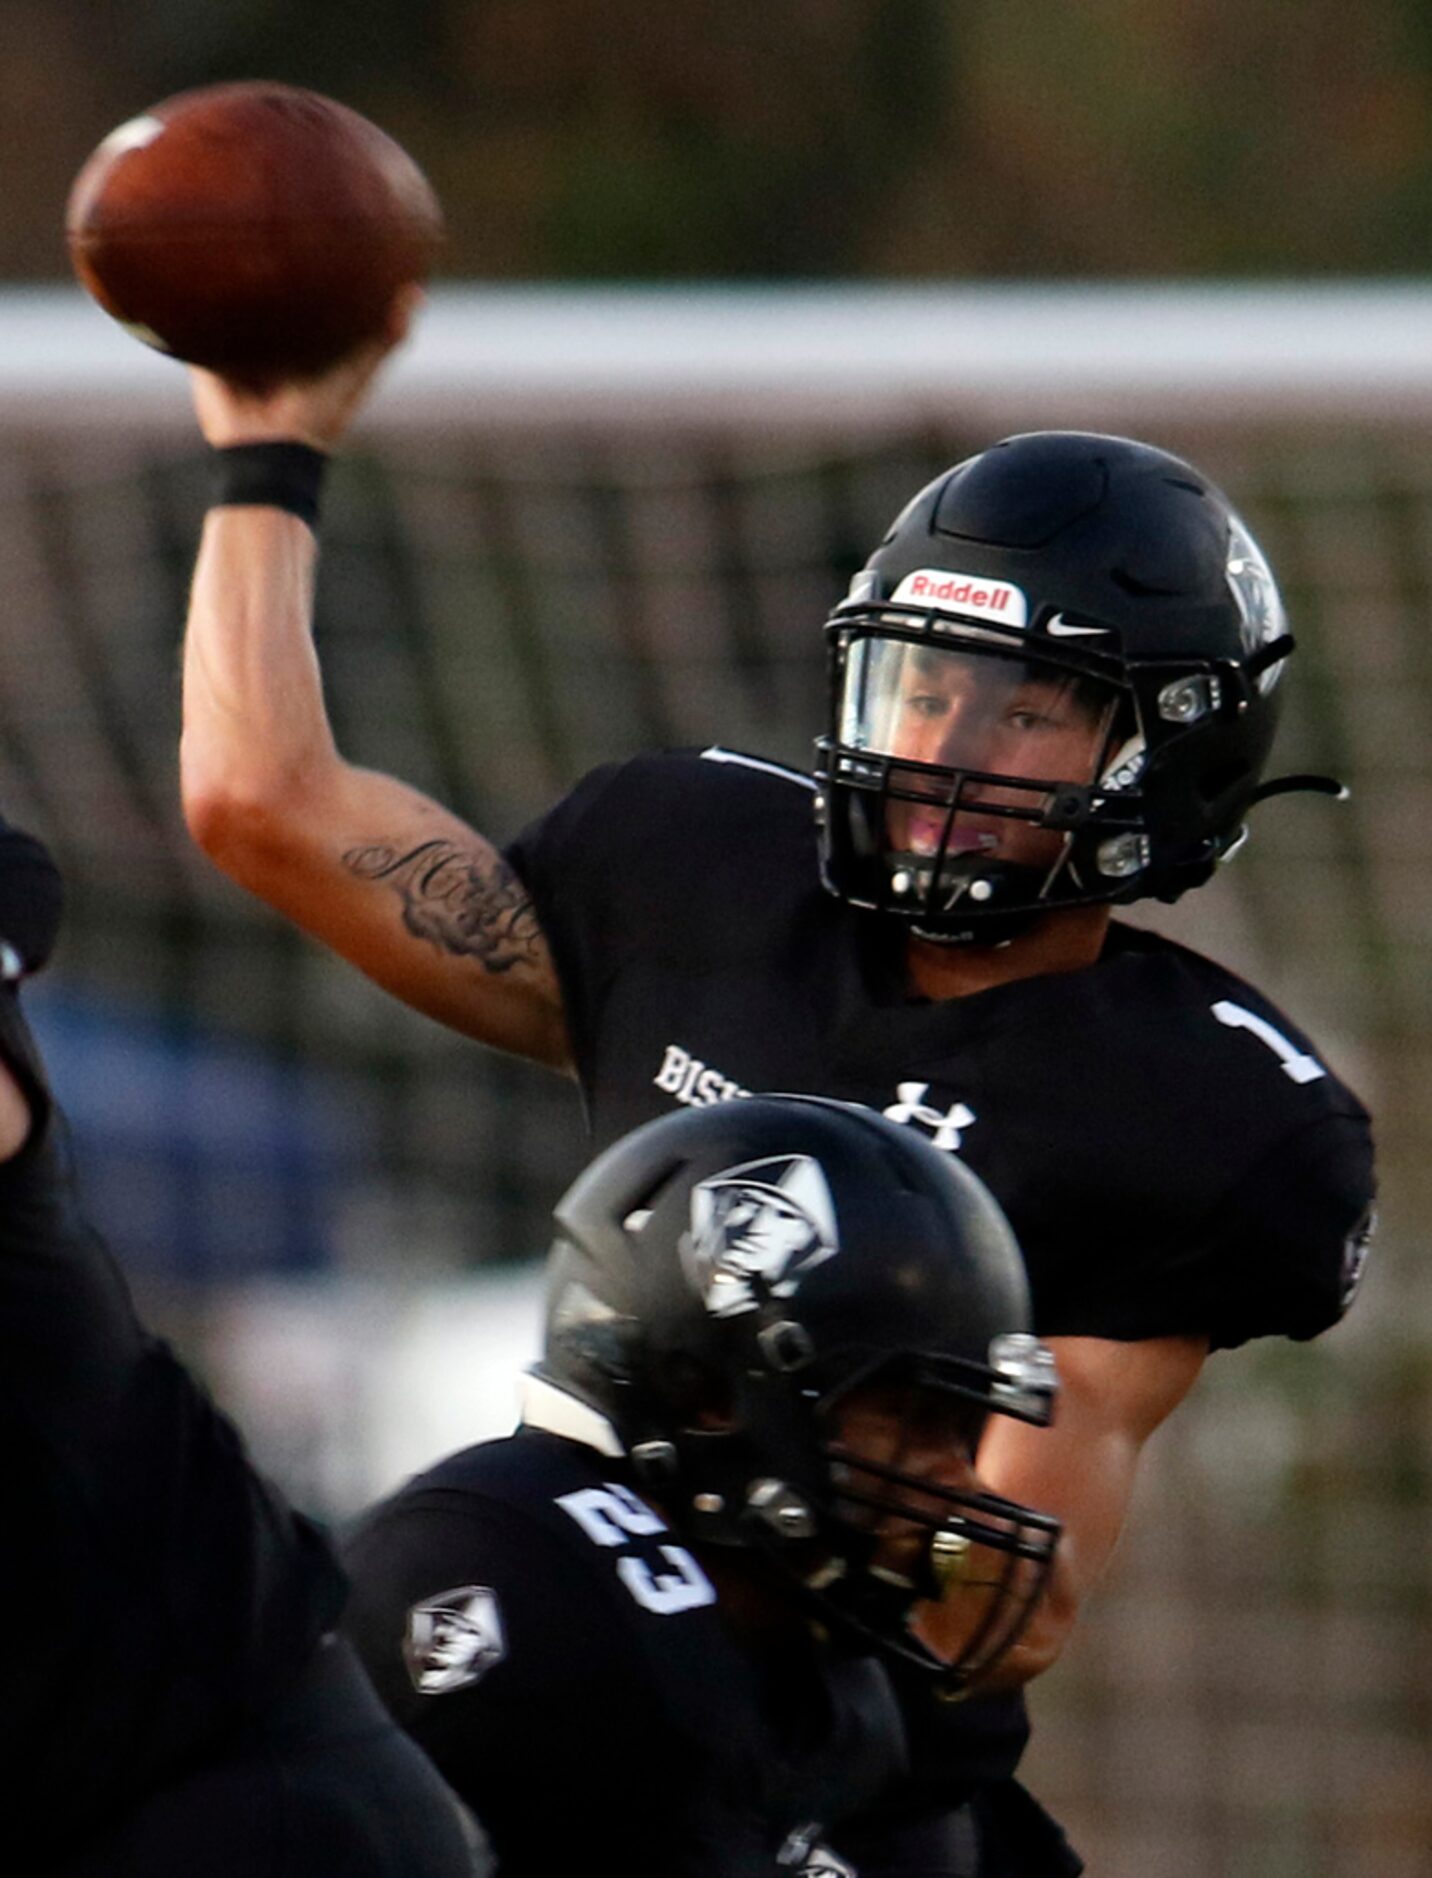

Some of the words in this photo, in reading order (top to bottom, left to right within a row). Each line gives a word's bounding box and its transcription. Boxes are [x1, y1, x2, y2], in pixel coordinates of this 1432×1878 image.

[910, 575, 1011, 610] Riddell
[1210, 1000, 1327, 1084] 1
[553, 1482, 717, 1616] 23
